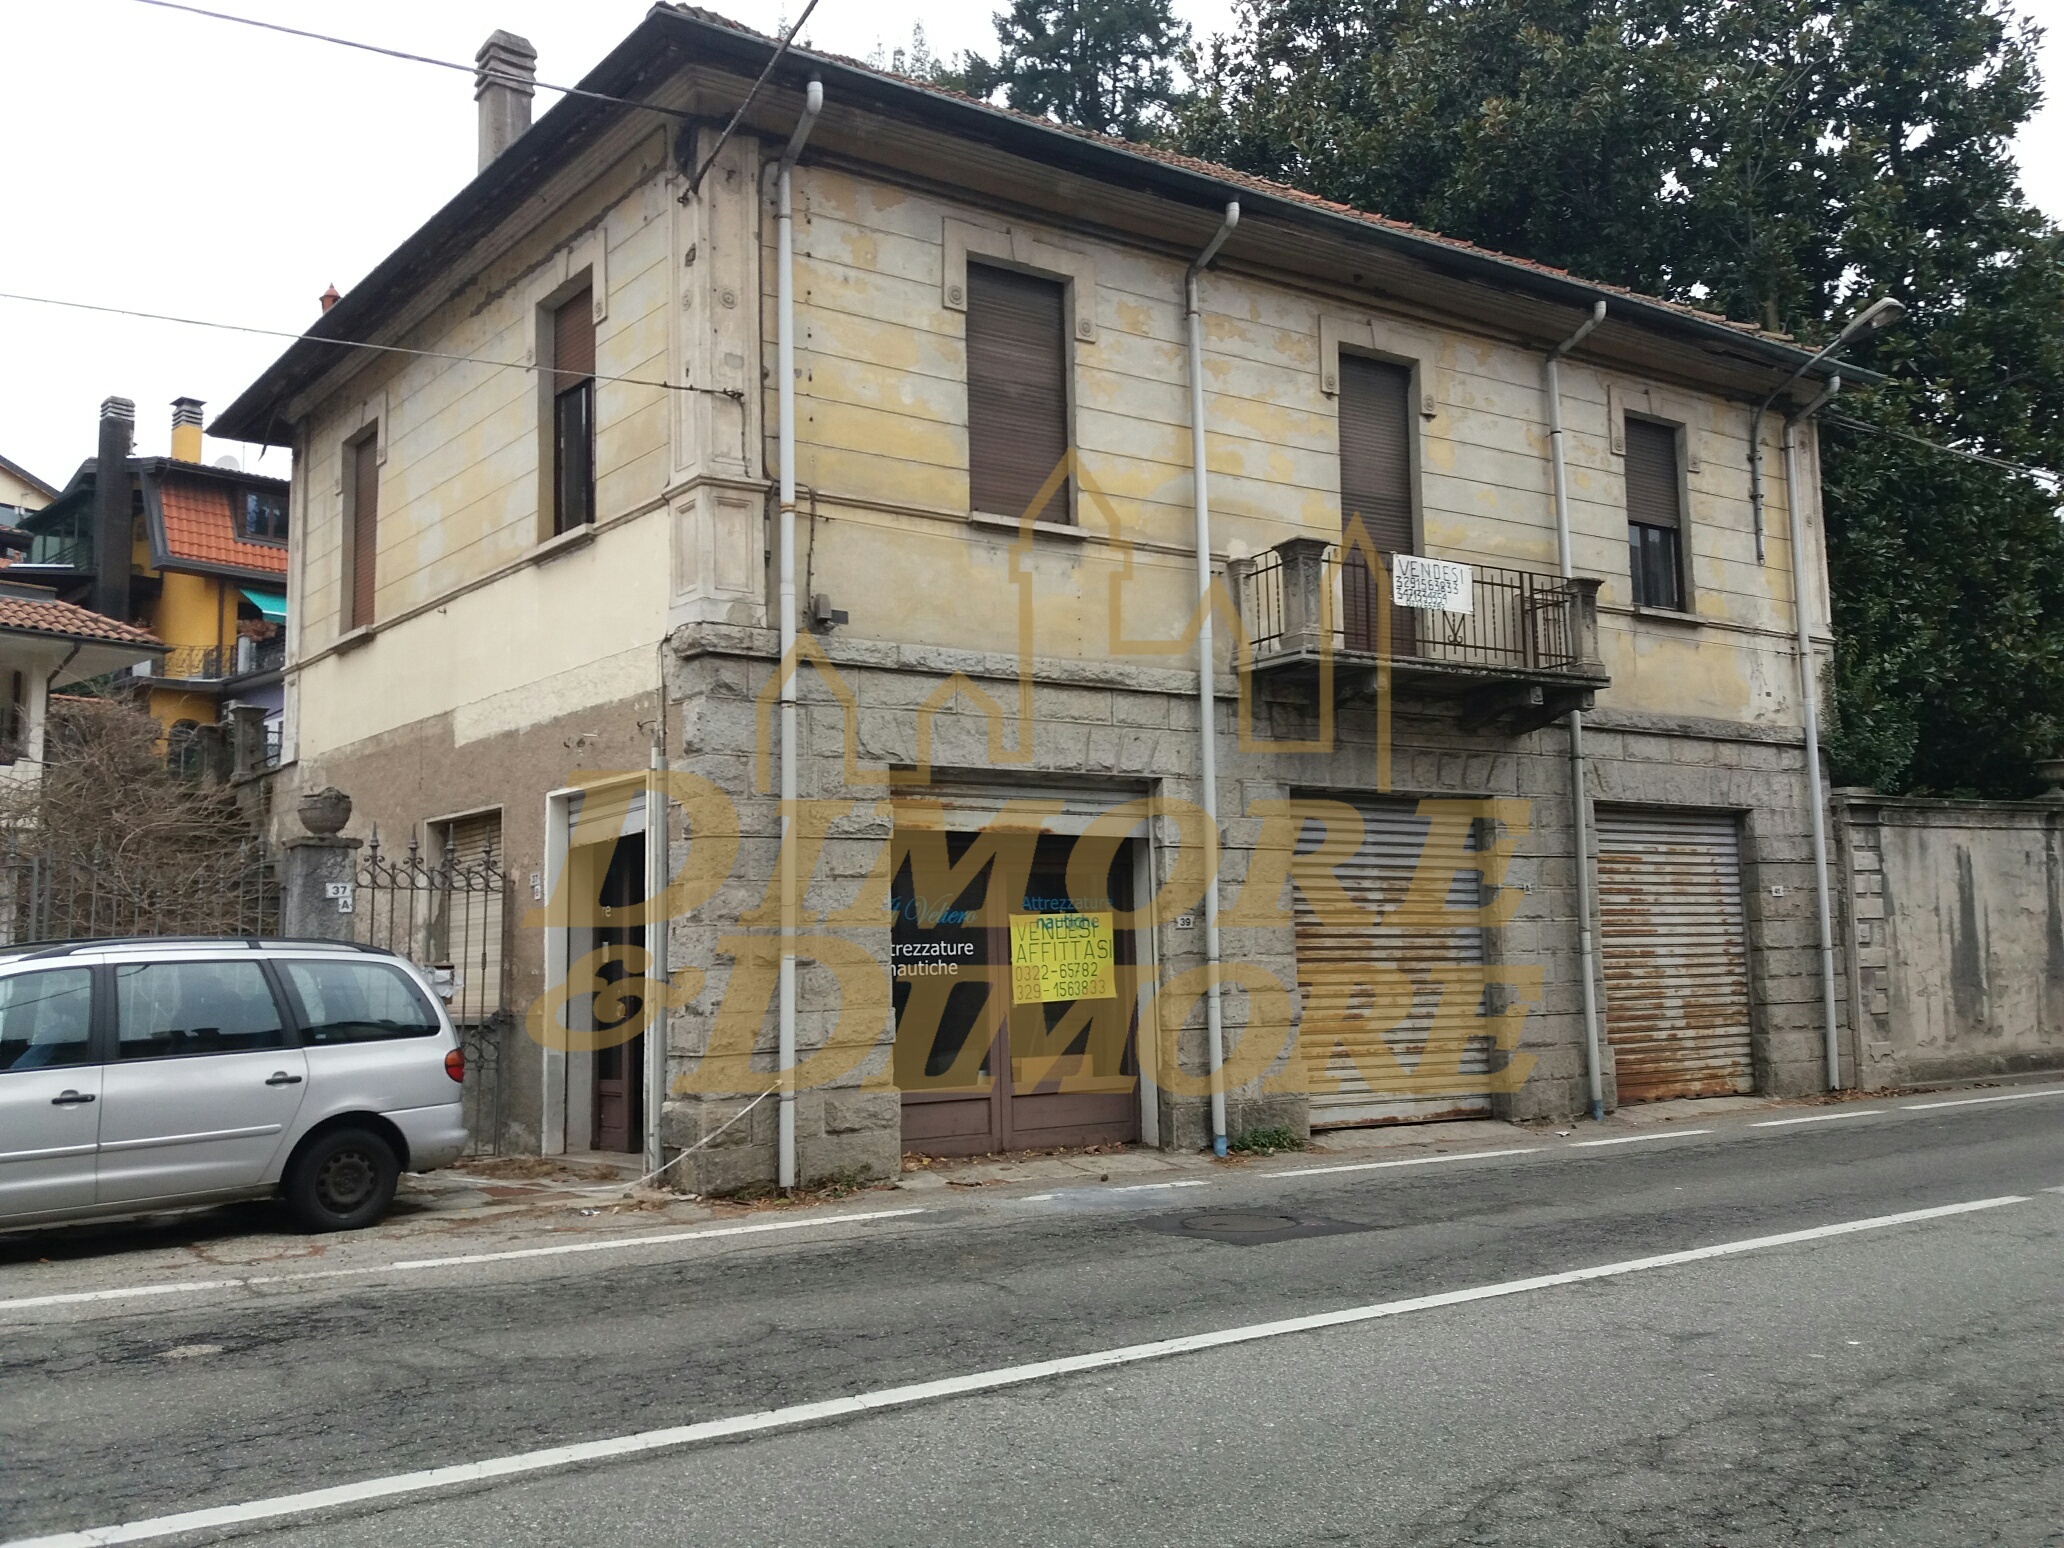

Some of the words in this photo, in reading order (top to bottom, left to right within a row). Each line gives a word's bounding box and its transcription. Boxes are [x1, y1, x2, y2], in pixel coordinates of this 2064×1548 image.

[1398, 558, 1464, 585] VENDESI
[1395, 575, 1459, 594] 3291563833
[332, 885, 347, 896] 37
[341, 899, 350, 909] A
[1022, 896, 1113, 910] Attrezzature
[1179, 917, 1191, 927] 39
[1016, 939, 1113, 964] AFFITTASI
[1015, 961, 1098, 982] 0322-65782
[1016, 979, 1106, 1001] 329-1563833
